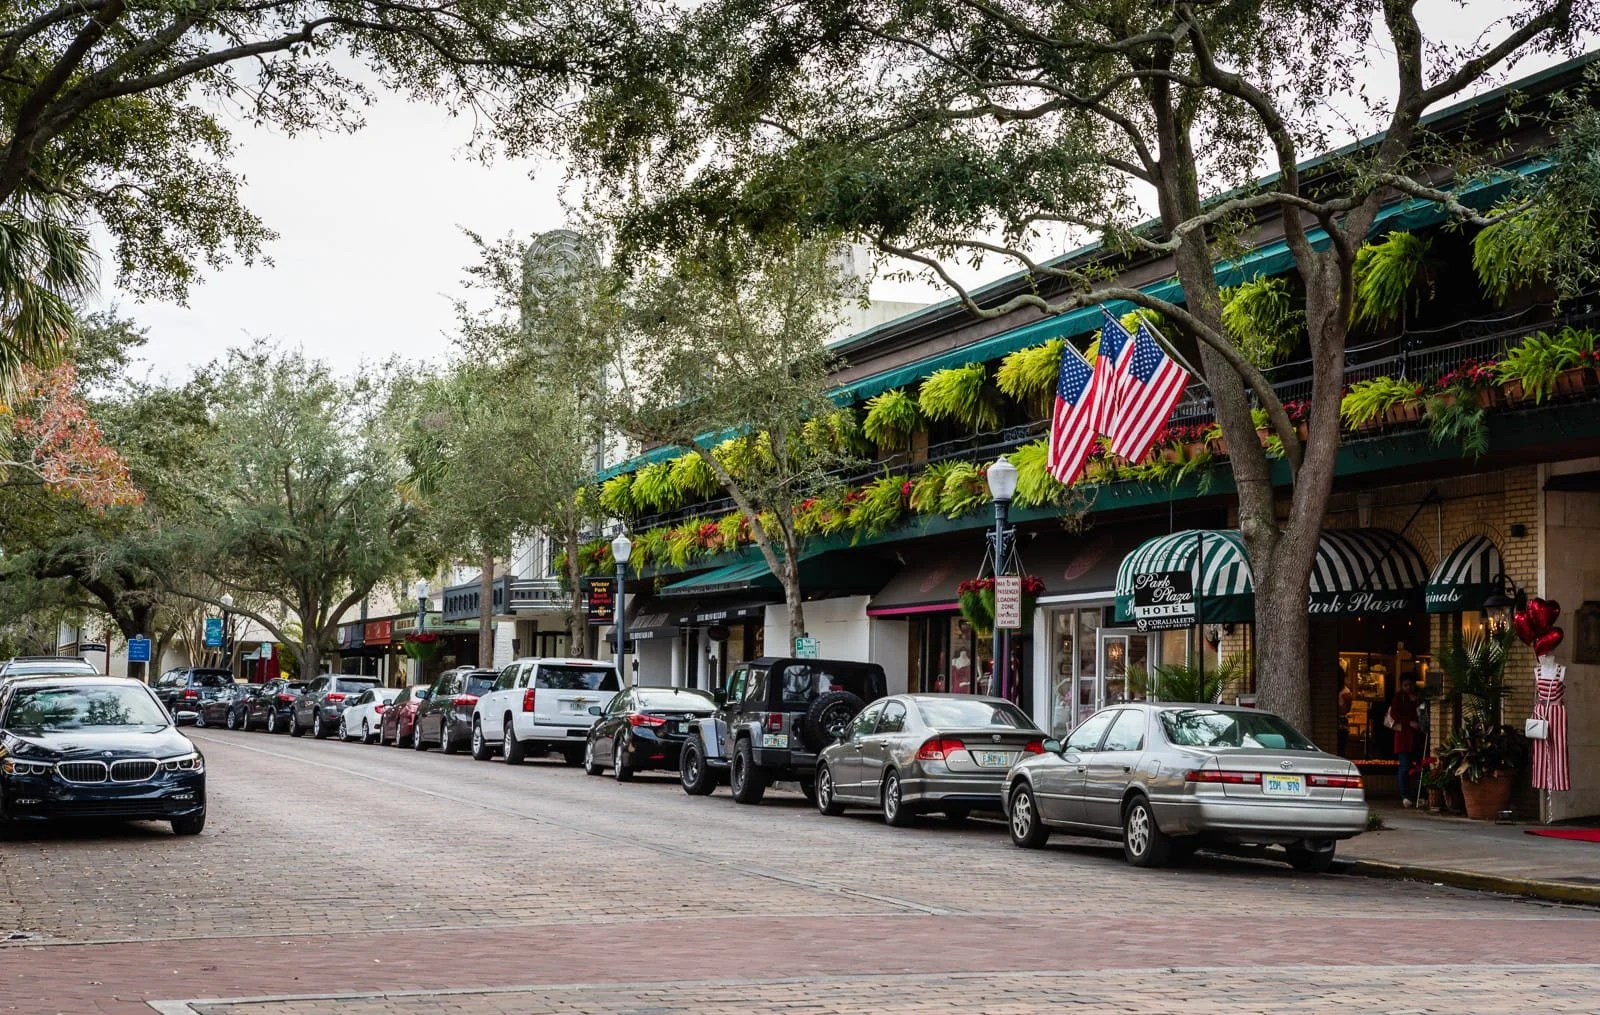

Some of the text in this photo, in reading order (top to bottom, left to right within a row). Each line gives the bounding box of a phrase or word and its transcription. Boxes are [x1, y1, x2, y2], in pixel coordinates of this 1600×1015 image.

[1135, 573, 1171, 590] Park
[1152, 586, 1192, 607] Plaza
[1308, 592, 1409, 613] ark Plaza
[1143, 605, 1188, 615] HOTEL
